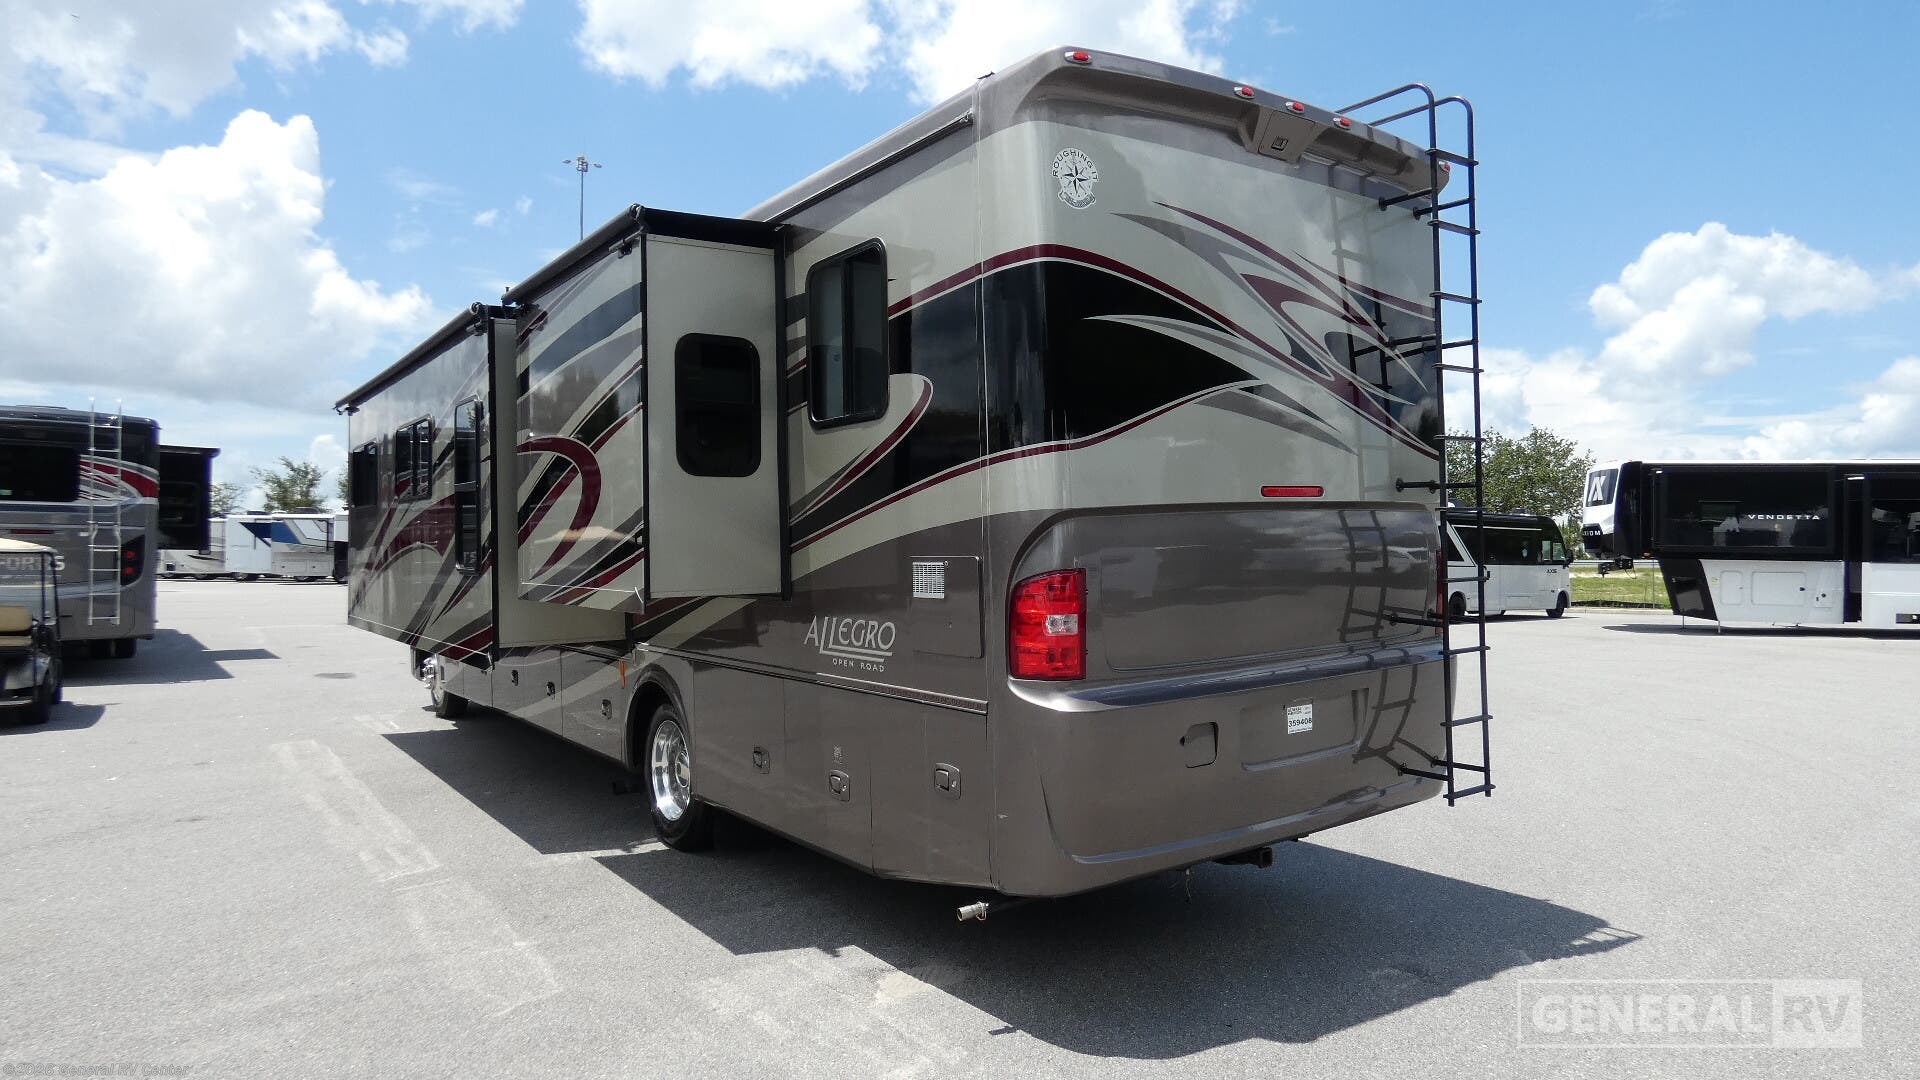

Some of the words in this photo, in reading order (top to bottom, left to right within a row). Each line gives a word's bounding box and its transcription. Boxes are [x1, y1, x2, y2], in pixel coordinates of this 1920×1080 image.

[1052, 150, 1092, 177] ROUGHING
[804, 615, 895, 660] ALLEGRO
[832, 657, 854, 668] OPEN
[860, 662, 885, 673] ROAD
